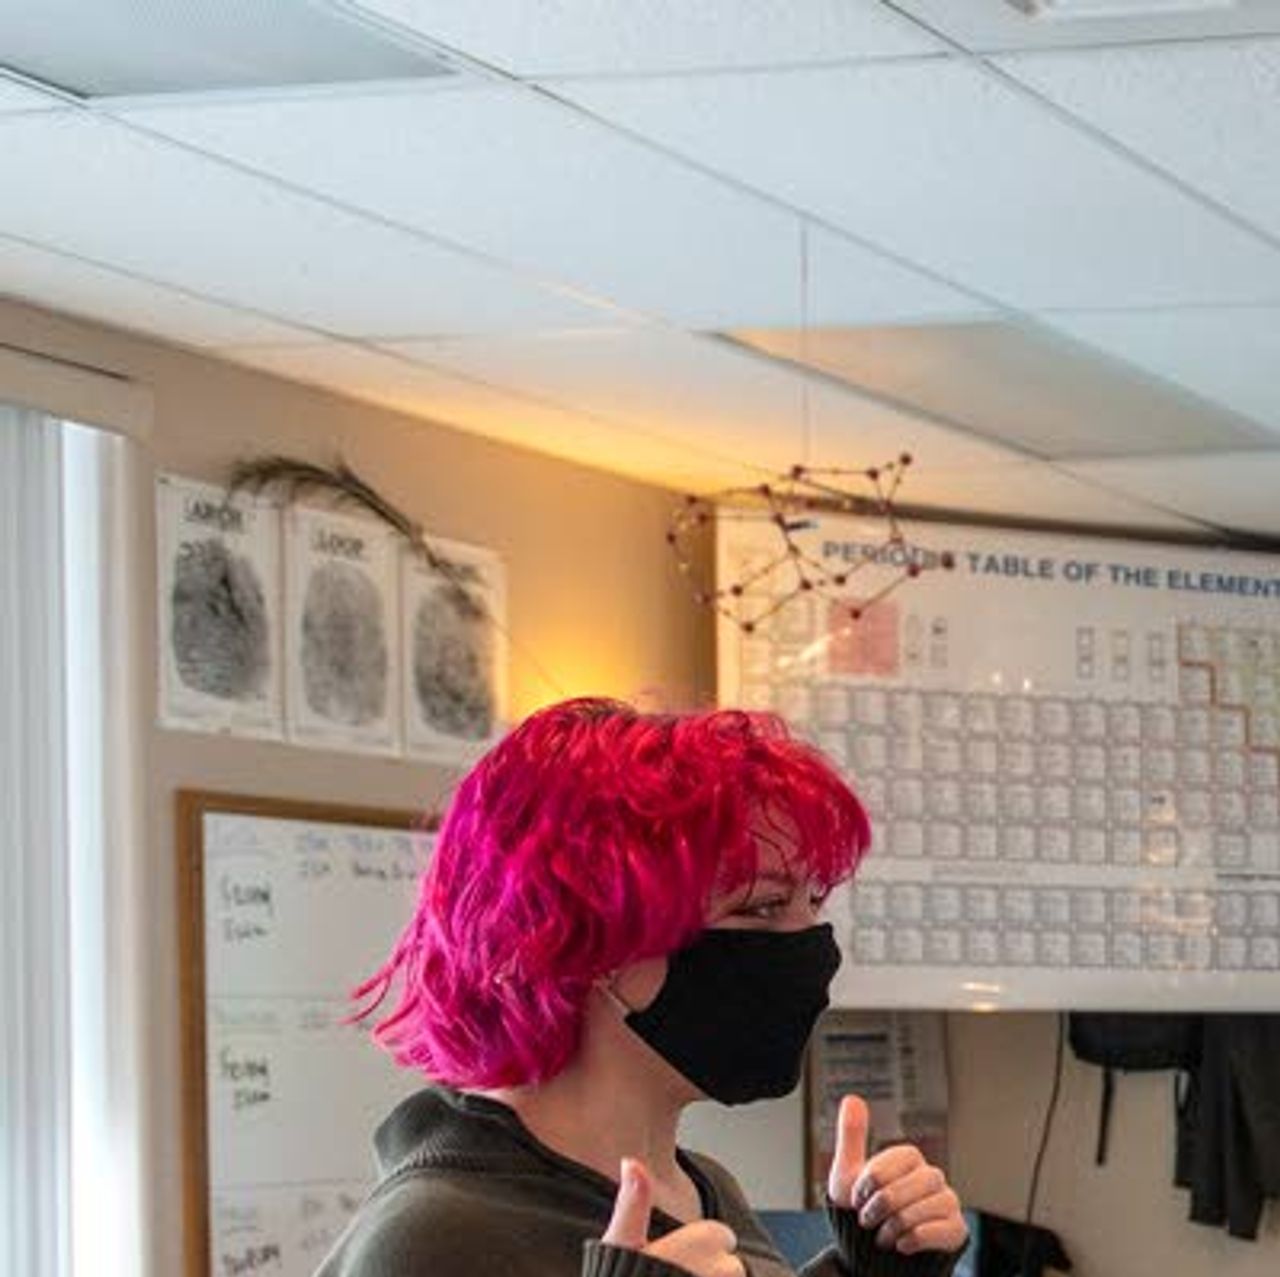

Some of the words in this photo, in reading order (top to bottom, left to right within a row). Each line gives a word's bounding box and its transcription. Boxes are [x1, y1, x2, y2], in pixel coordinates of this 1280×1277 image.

[967, 552, 1052, 579] TABLE
[1062, 563, 1102, 584] OF
[1110, 566, 1158, 588] THE
